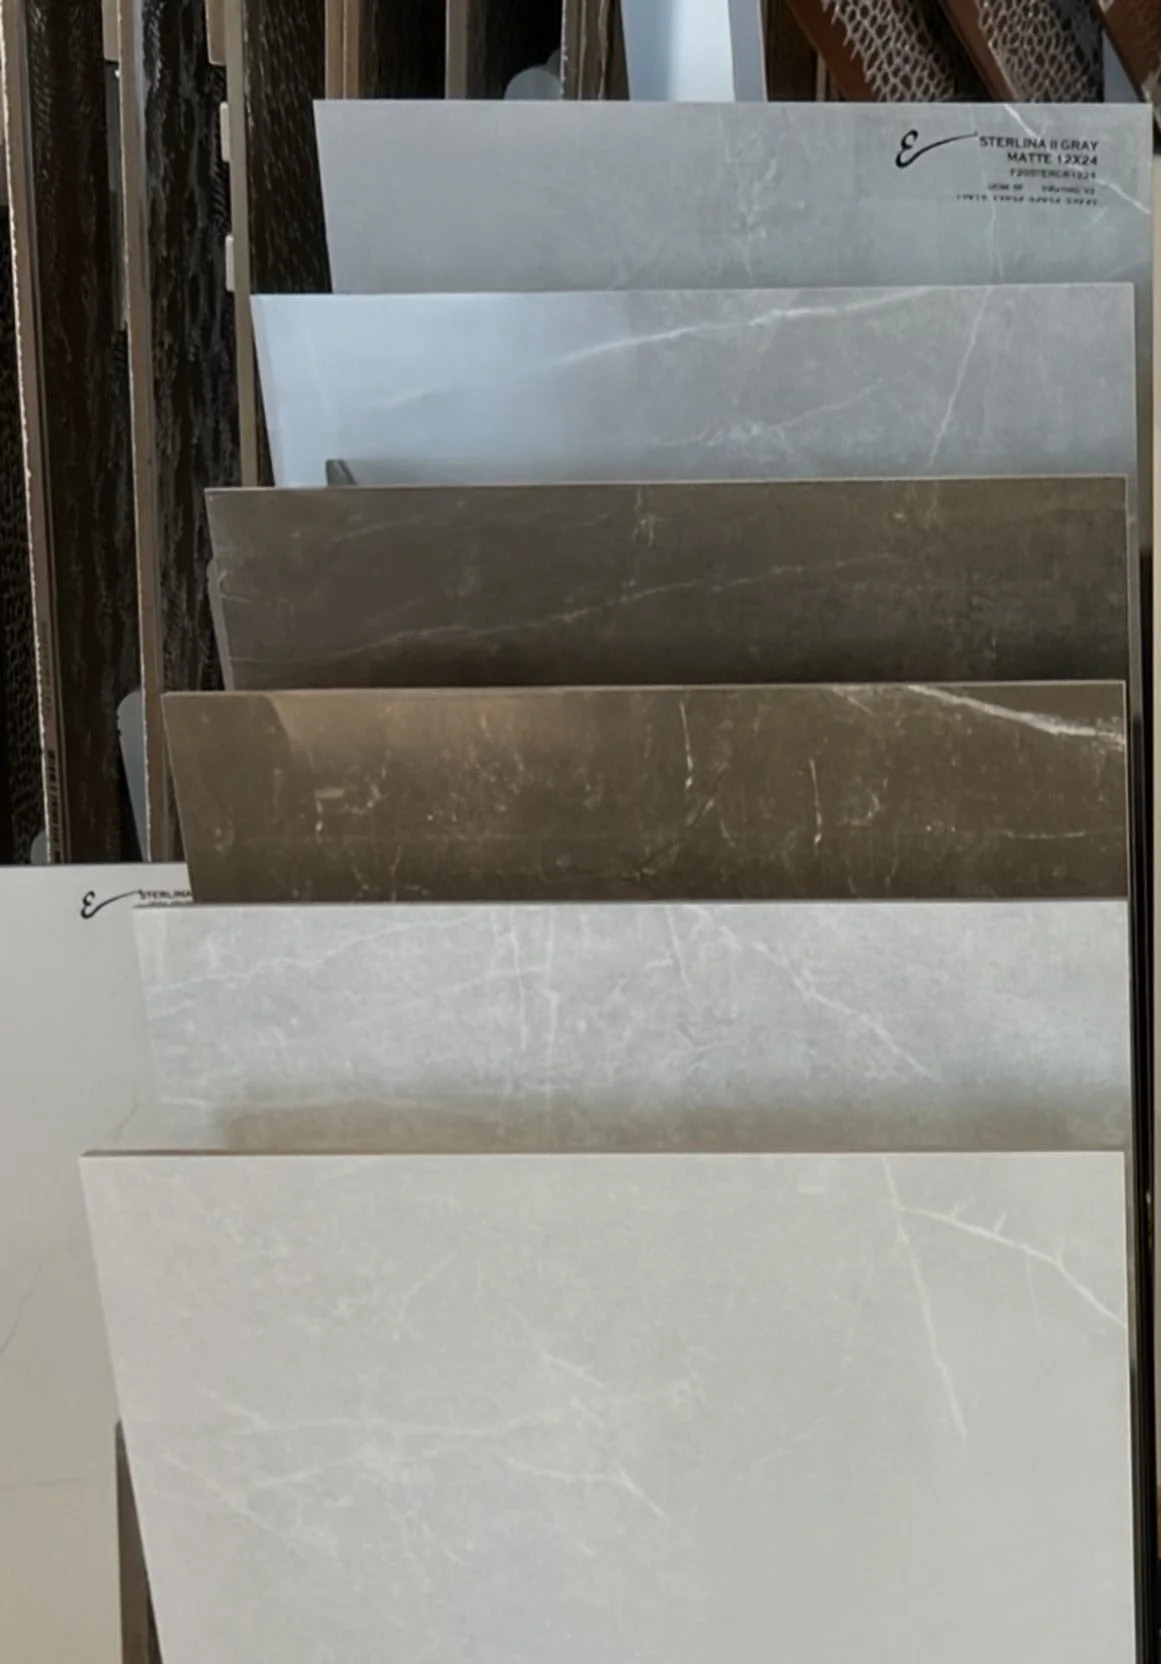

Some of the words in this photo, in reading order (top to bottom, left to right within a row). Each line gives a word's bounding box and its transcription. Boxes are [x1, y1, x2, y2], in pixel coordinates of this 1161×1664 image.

[979, 135, 1046, 150] STERLINA
[1060, 140, 1098, 151] GRAY
[1007, 152, 1052, 165] MATTE
[1056, 153, 1098, 166] 12X24
